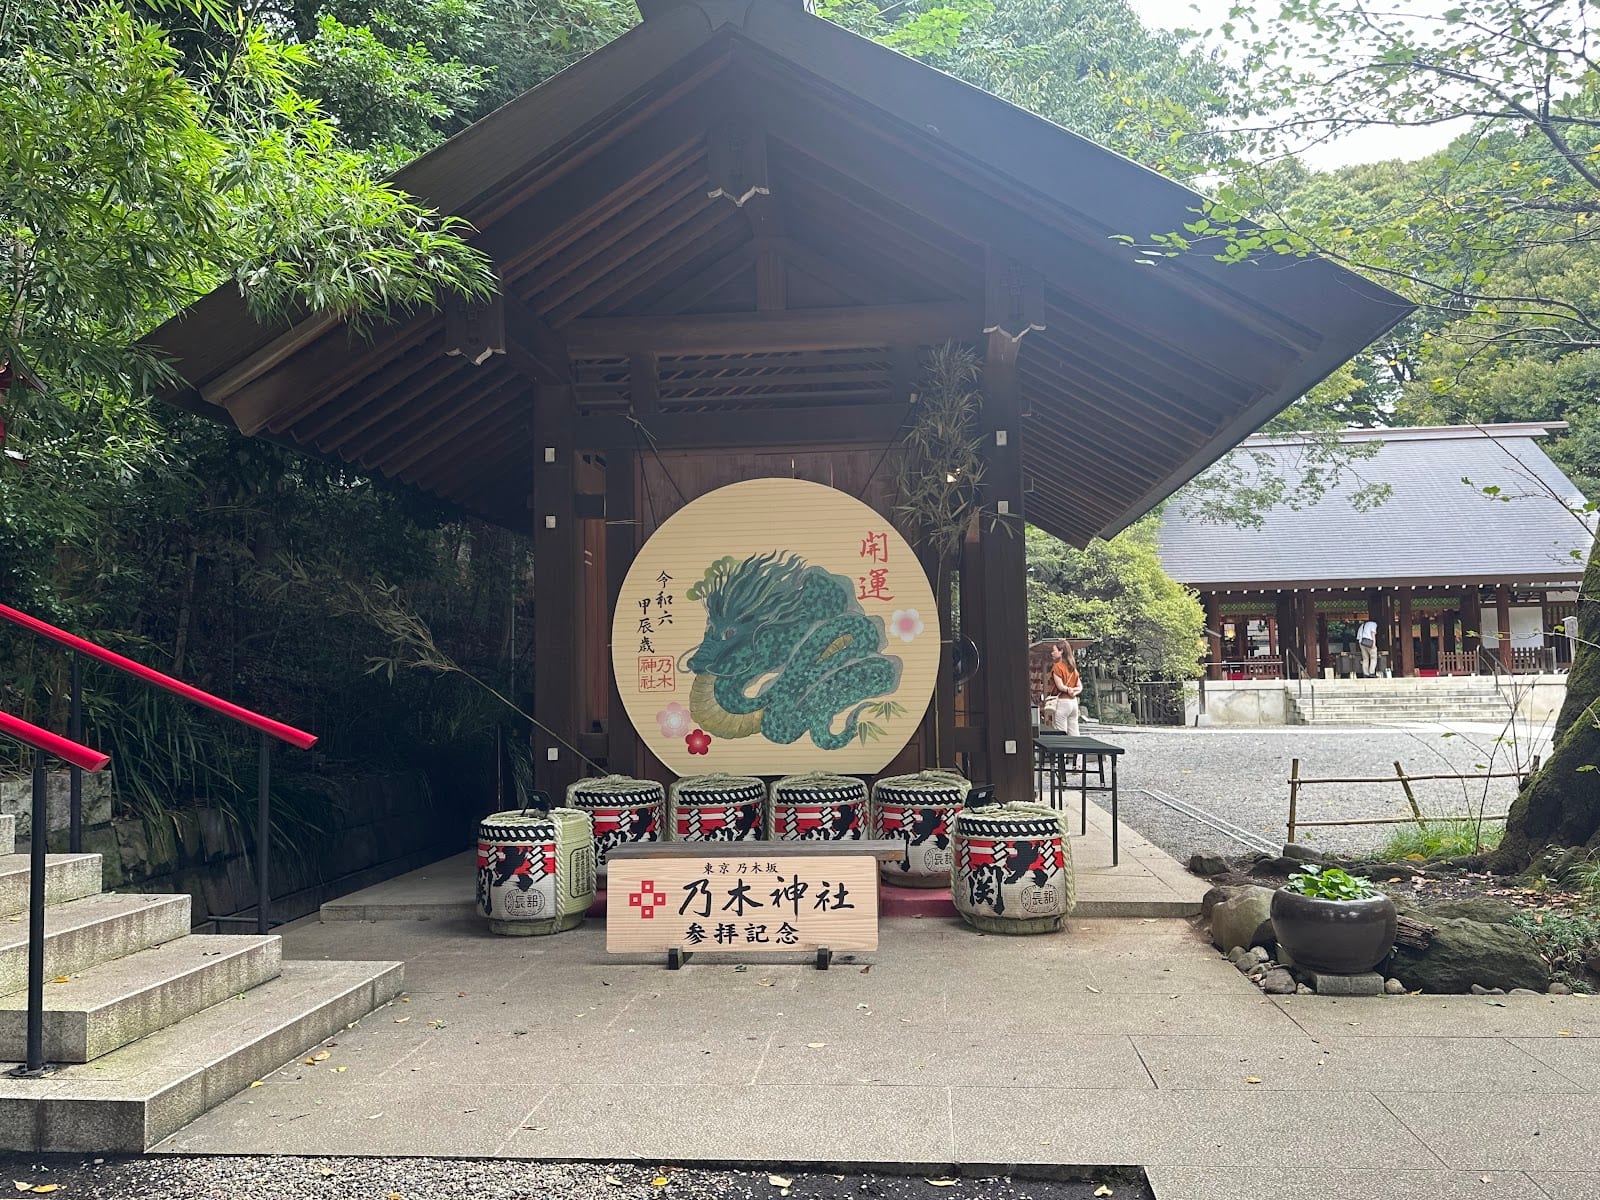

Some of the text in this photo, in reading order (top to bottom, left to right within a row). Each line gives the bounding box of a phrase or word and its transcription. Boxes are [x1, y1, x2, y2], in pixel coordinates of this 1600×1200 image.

[858, 530, 895, 602] 開運
[656, 570, 673, 626] 令和六
[637, 598, 655, 654] 甲辰歳
[640, 659, 657, 690] 神社
[656, 659, 673, 688] 乃木
[678, 874, 855, 922] 乃木神社
